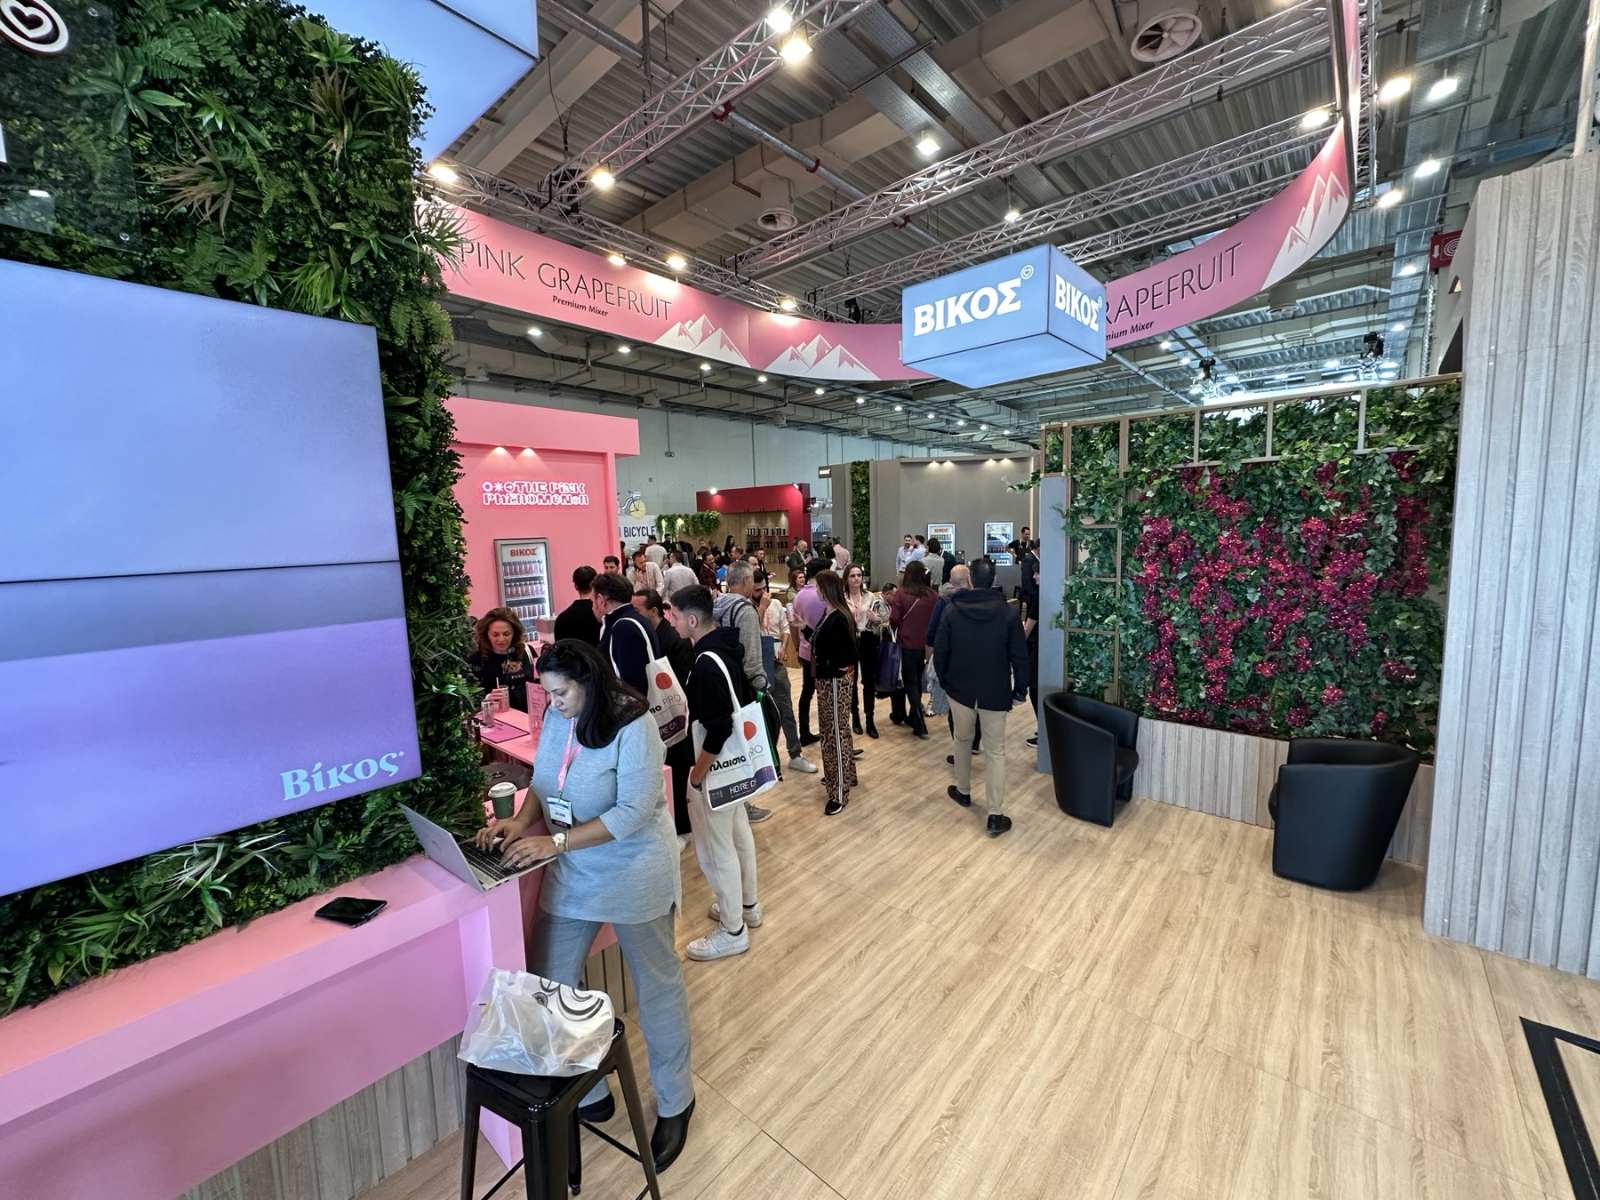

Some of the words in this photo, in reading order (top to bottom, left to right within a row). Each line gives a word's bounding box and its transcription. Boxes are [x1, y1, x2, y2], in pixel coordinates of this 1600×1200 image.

[460, 240, 525, 280] PINK
[538, 262, 672, 320] GRAPEFRUIT
[1055, 274, 1100, 332] ΒΙΚΟΣ
[552, 295, 586, 311] Premium
[588, 305, 608, 317] Mixer
[914, 278, 1021, 336] ΒΙΚΟΣ
[1130, 321, 1154, 334] Mixer
[623, 526, 656, 538] BICYCLE
[280, 752, 399, 801] Βίκος
